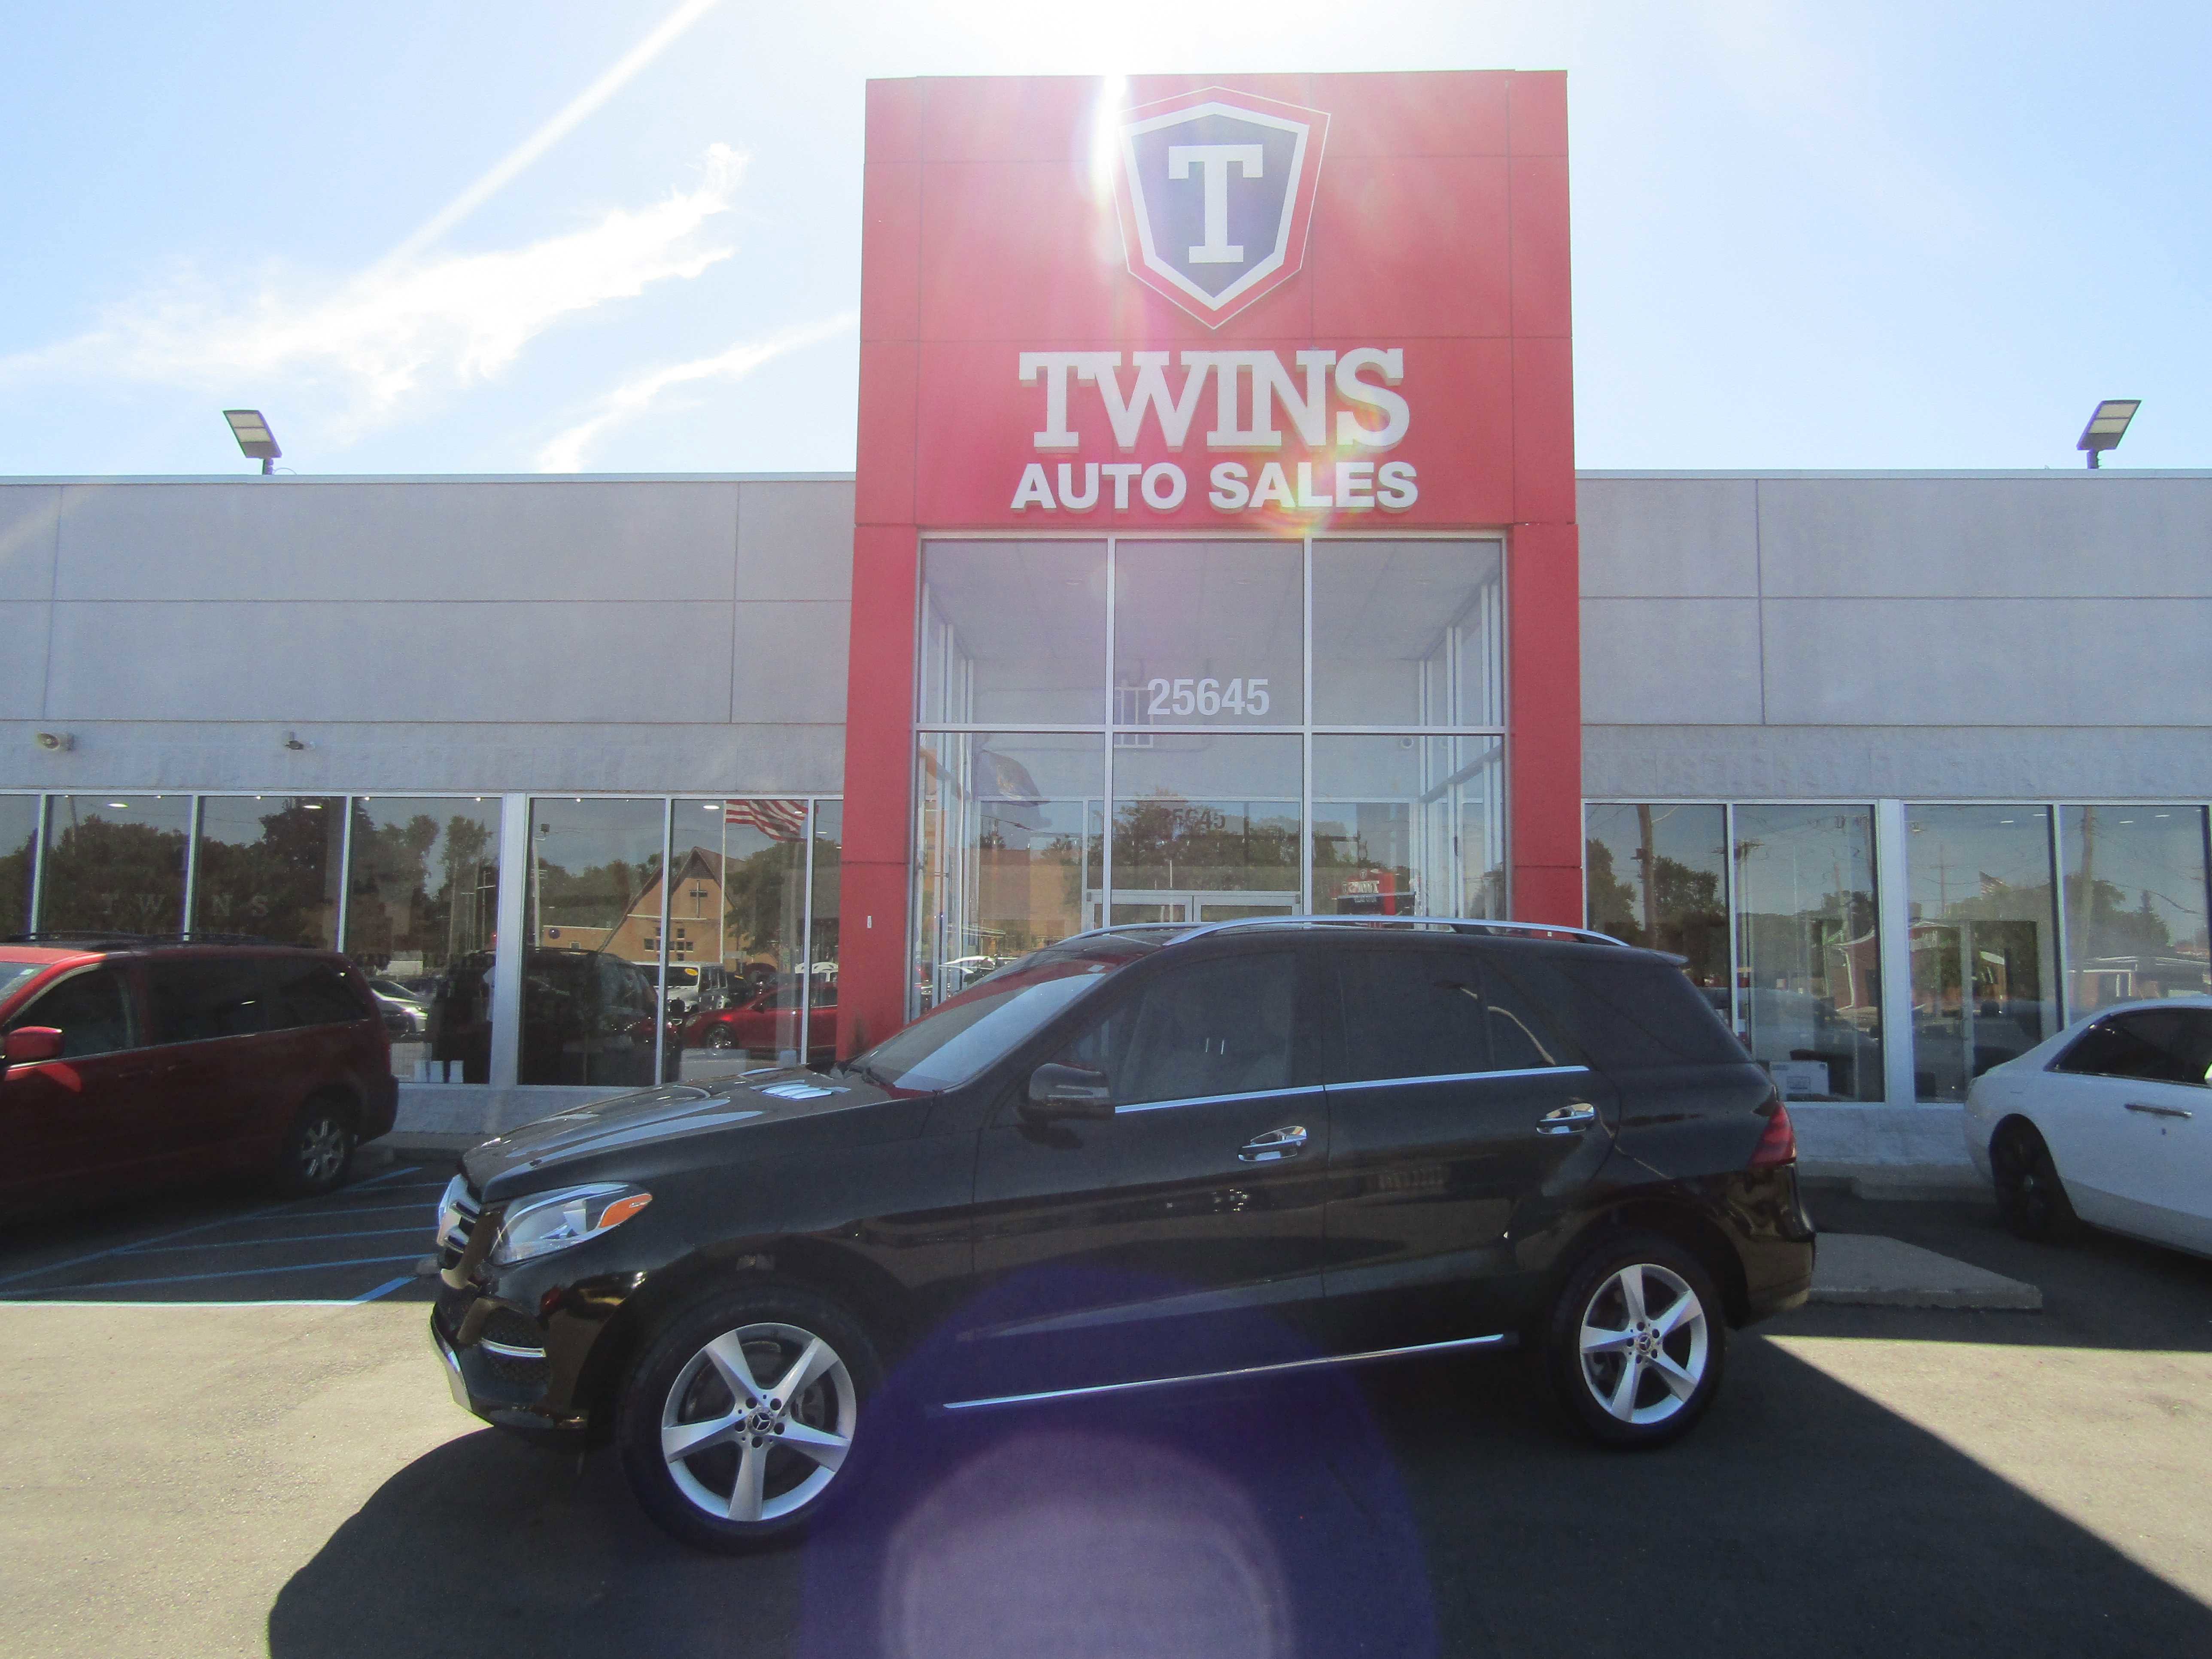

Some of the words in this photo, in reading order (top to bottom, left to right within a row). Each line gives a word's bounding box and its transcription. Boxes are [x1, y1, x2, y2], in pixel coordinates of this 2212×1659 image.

[1169, 144, 1264, 264] T
[1019, 347, 1410, 453] TWINS
[1010, 462, 1188, 513] AUTO
[1208, 461, 1419, 512] SALES
[1147, 678, 1270, 716] 25645
